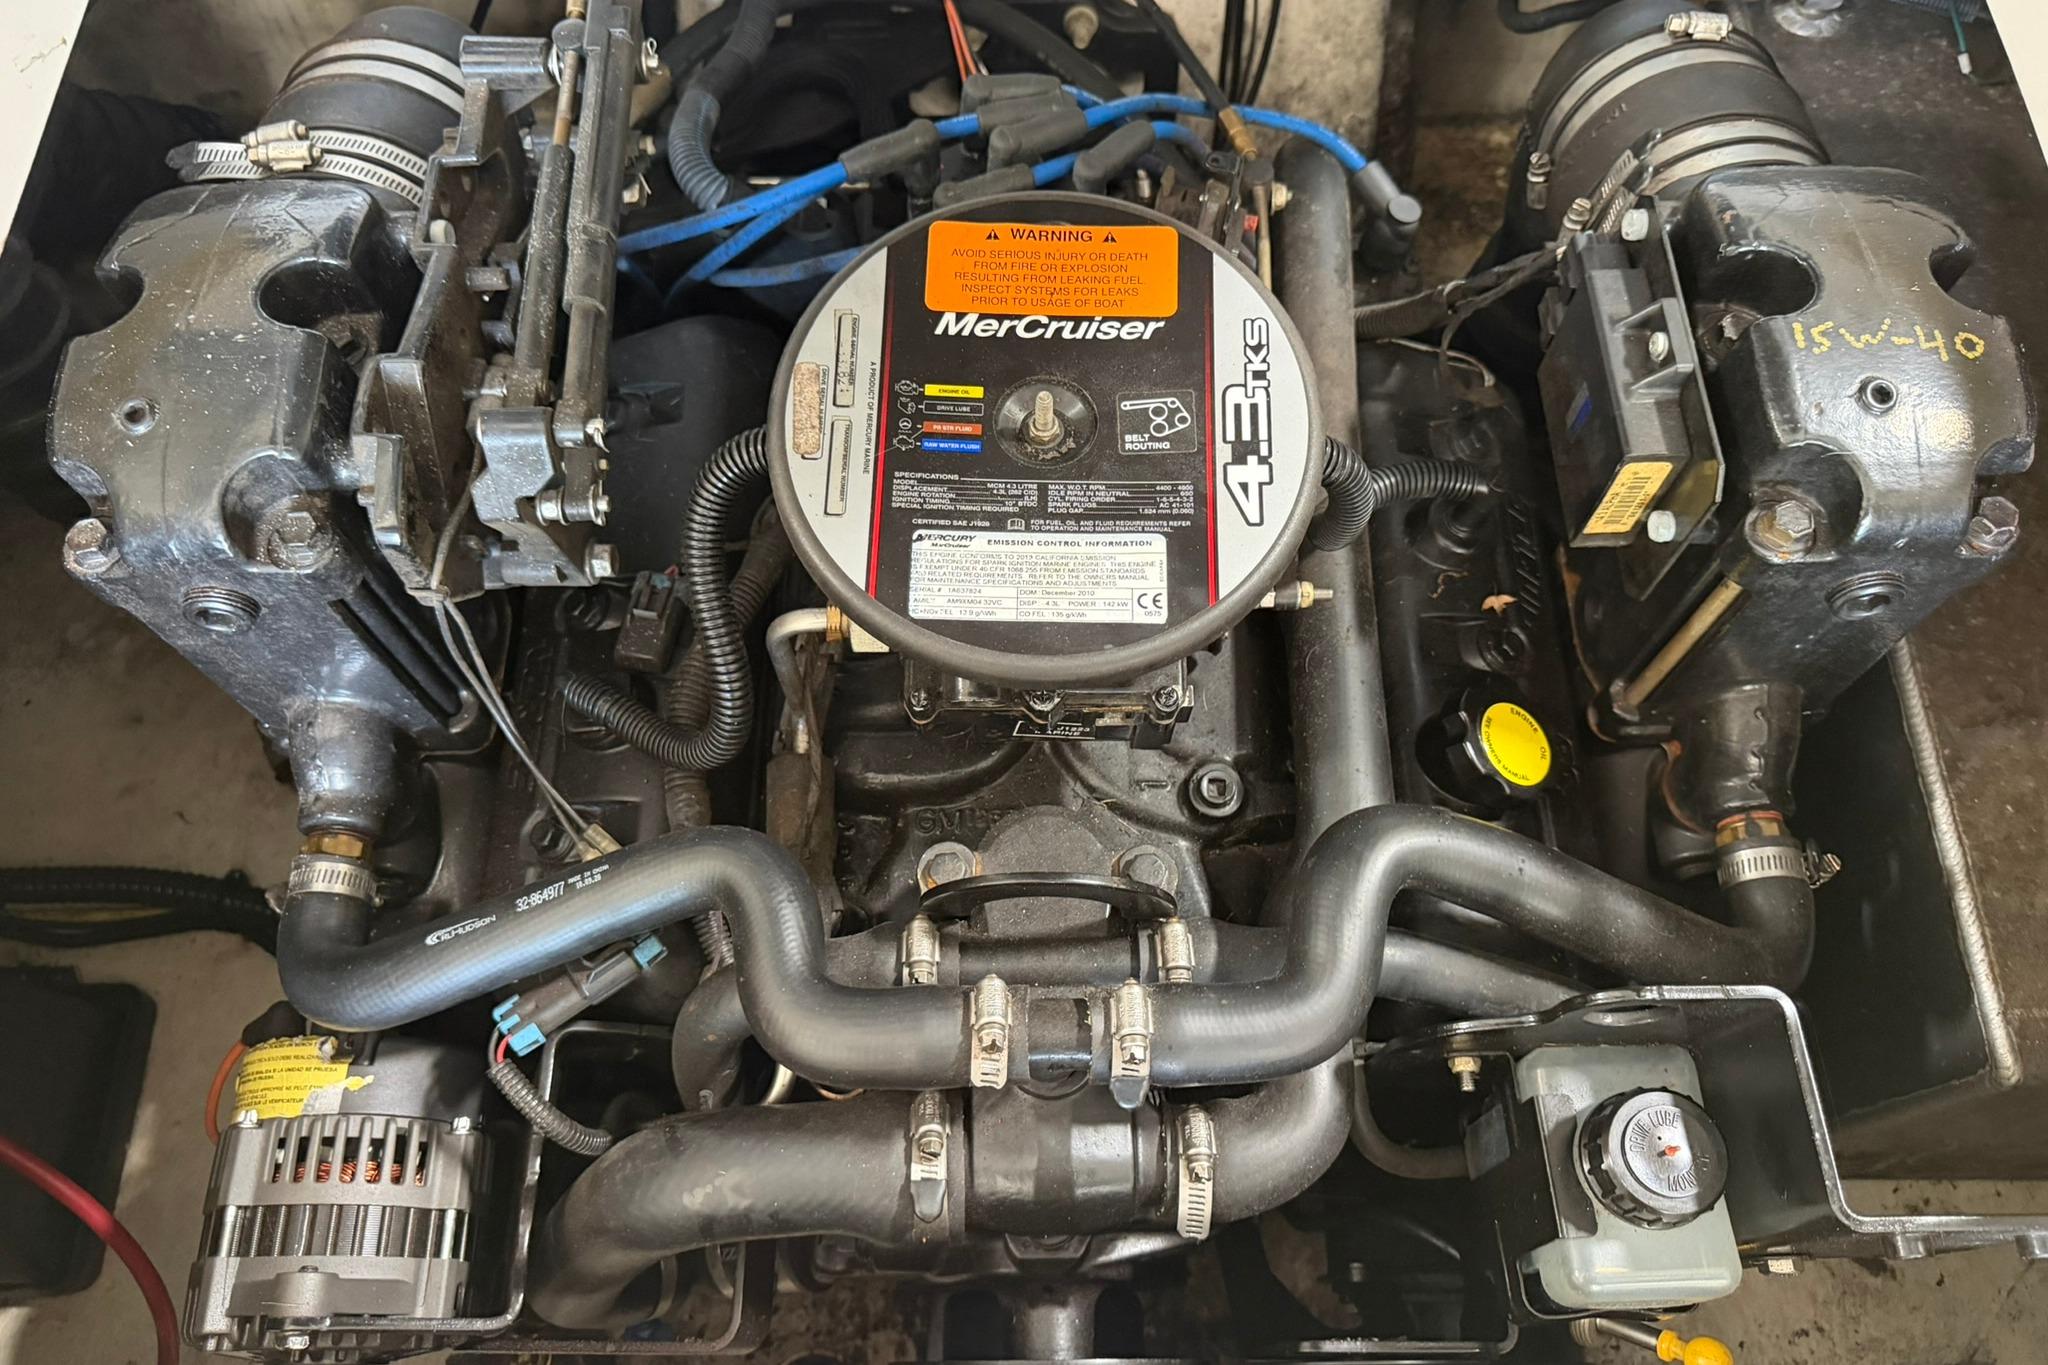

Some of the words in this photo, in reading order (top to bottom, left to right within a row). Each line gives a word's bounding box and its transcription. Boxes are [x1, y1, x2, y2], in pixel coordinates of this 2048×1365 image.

[1010, 228, 1093, 242] WARNING
[952, 248, 986, 258] AVOID
[990, 249, 1041, 260] SERIOUS
[1044, 250, 1086, 261] INJURY
[1089, 252, 1106, 261] OR
[1110, 252, 1148, 262] DEATH
[974, 261, 1008, 271] FROM
[1011, 262, 1036, 272] FIRE
[1040, 262, 1058, 272] OR
[1062, 263, 1128, 274] EXPLOSION
[954, 272, 1020, 282] RESULTING
[1023, 273, 1057, 283] FROM
[1060, 274, 1110, 284] LEAKING
[1114, 275, 1143, 285] FUEL
[961, 284, 1012, 294] INSPECT
[1014, 285, 1070, 296] SYSTEMS
[1074, 286, 1098, 296] FOR
[1102, 286, 1139, 296] LEAKS
[972, 296, 1010, 306] PRIOR
[1013, 297, 1028, 306] TO
[1030, 297, 1072, 308] USAGE
[1075, 298, 1092, 308] OF
[1094, 298, 1126, 308] BOAT
[934, 312, 1165, 340] MerCruiser
[868, 368, 876, 398] PRODUCT
[867, 401, 874, 412] OF
[865, 412, 874, 447] MERCURY
[1125, 442, 1170, 450] ROUTING
[863, 448, 871, 474] MARINE
[894, 471, 960, 480] SPECIFICATIONS
[1510, 707, 1538, 734] ENGINE
[516, 881, 565, 912] 32-864977
